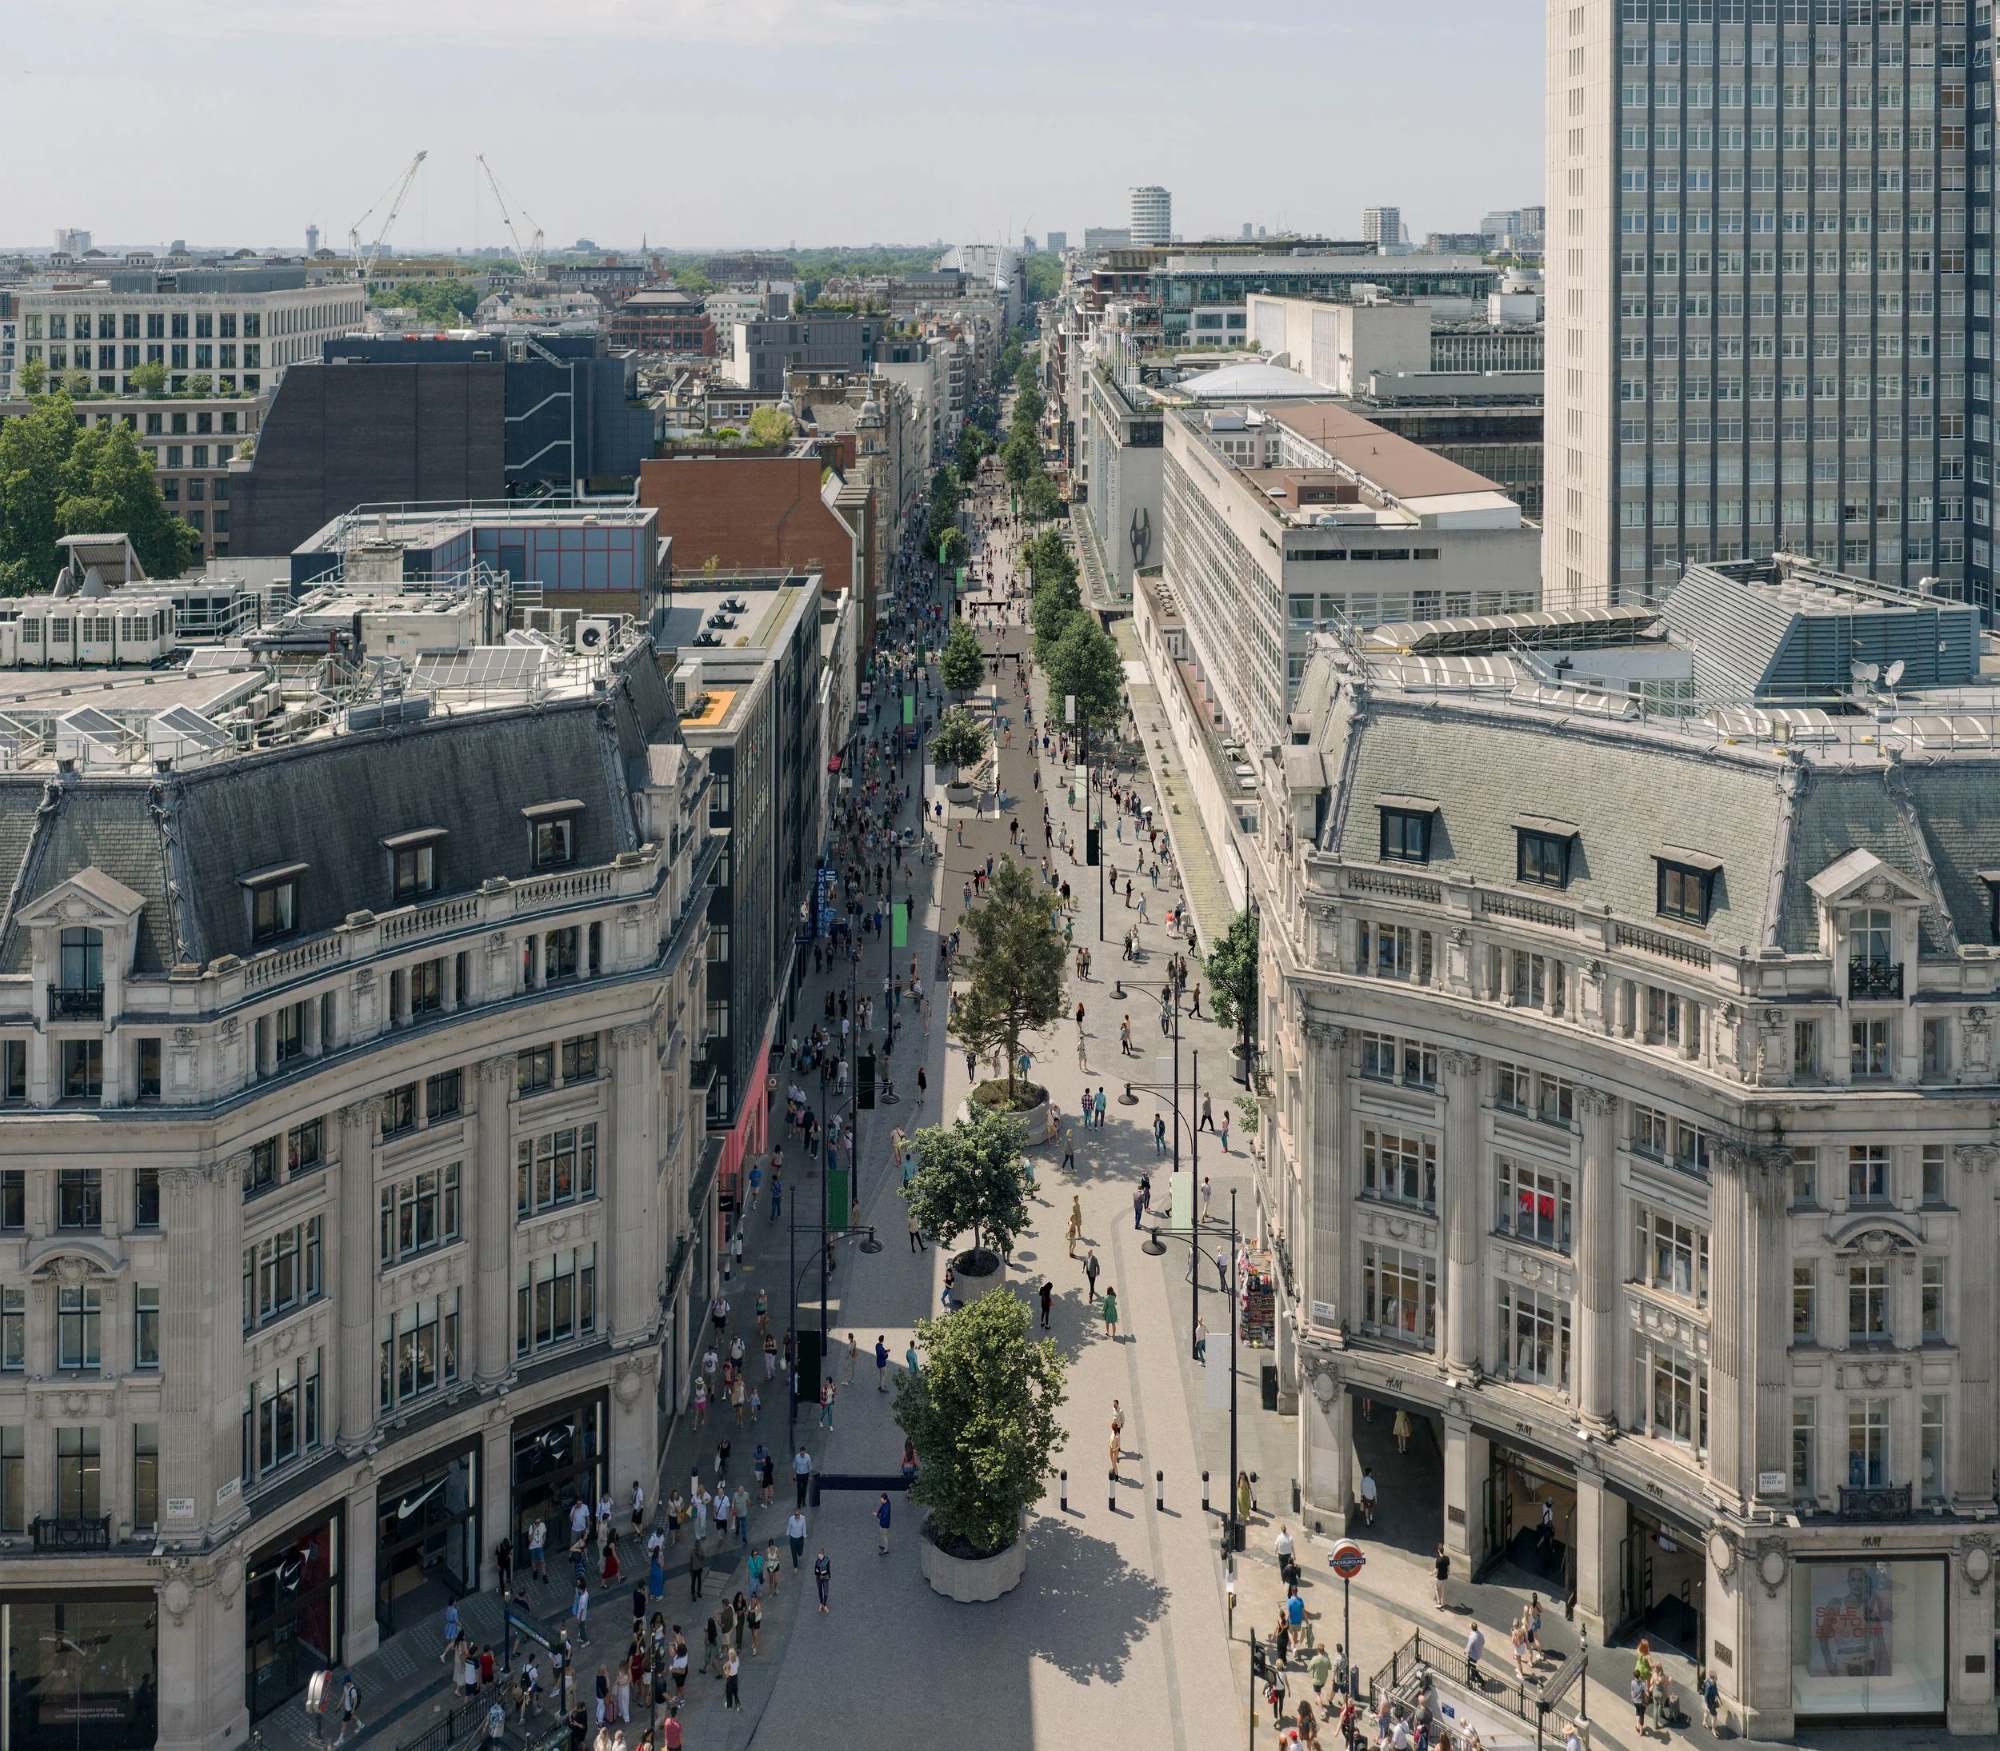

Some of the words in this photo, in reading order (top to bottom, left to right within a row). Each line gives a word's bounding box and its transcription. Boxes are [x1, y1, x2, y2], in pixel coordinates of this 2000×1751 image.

[1816, 1606, 1857, 1617] SALE
[1816, 1617, 1837, 1627] UP
[1840, 1617, 1862, 1627] TO
